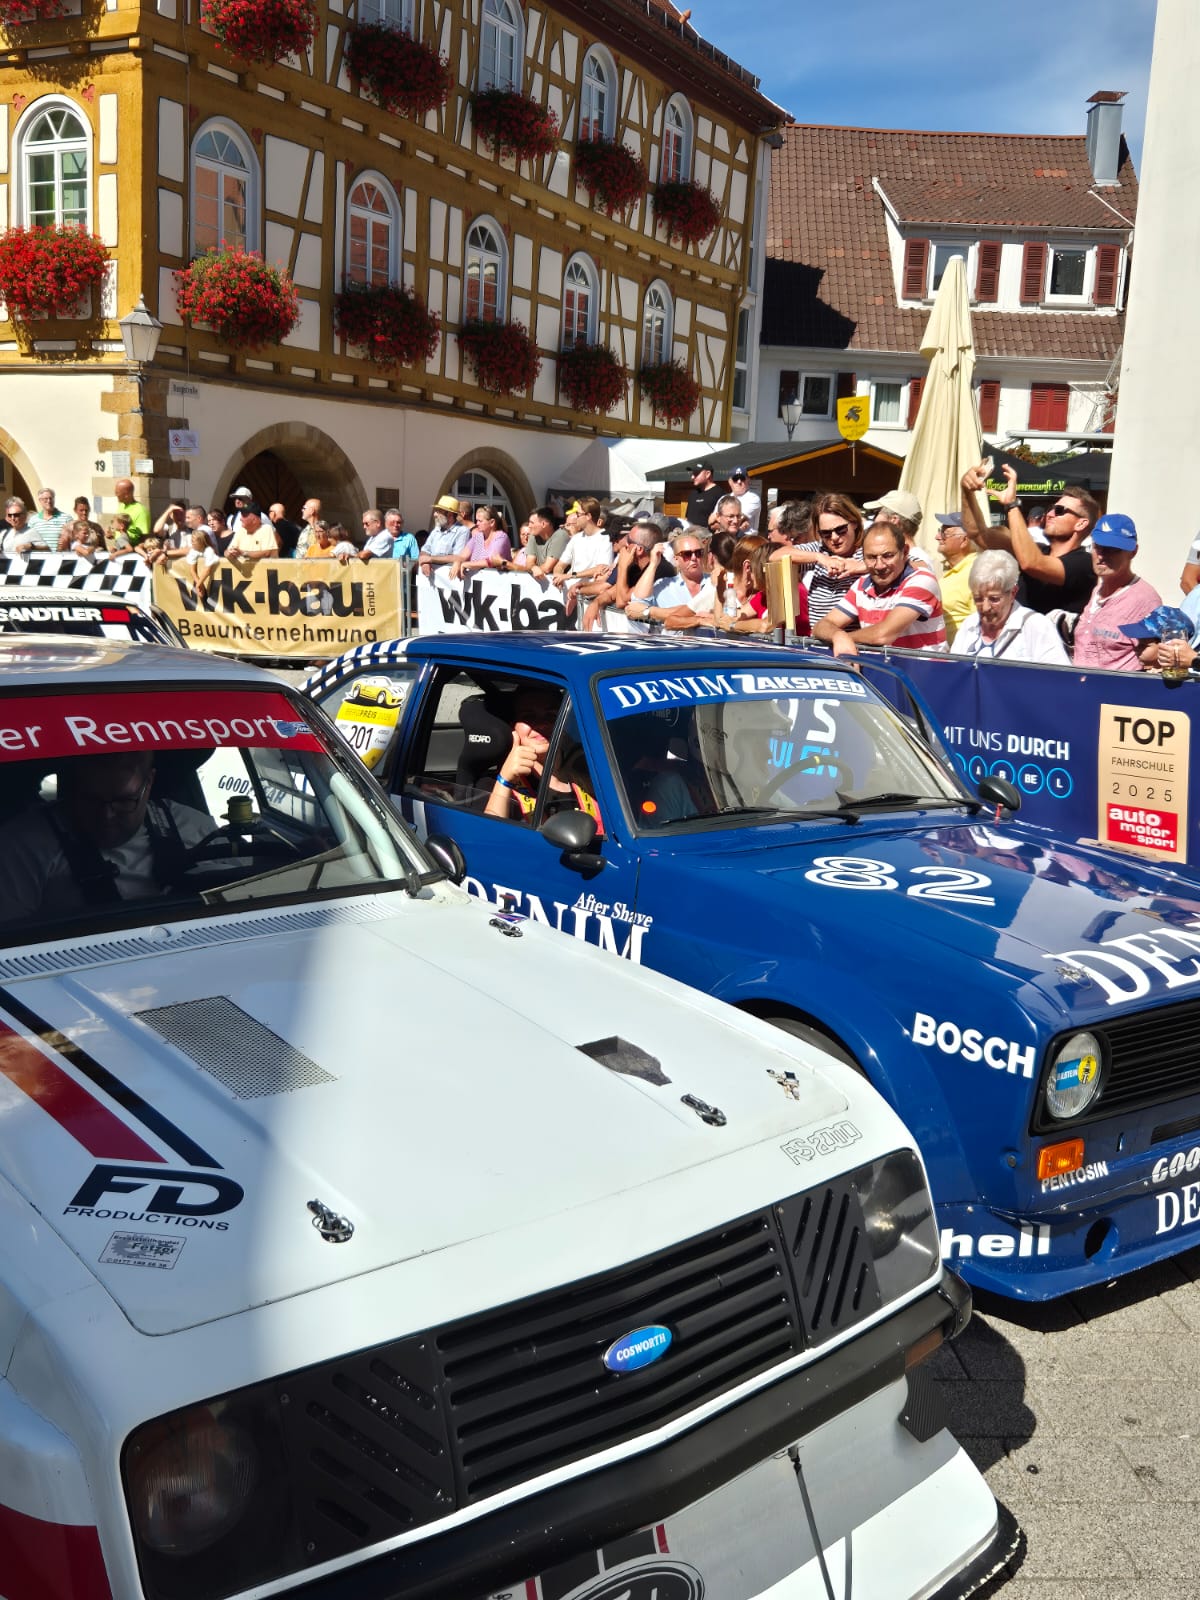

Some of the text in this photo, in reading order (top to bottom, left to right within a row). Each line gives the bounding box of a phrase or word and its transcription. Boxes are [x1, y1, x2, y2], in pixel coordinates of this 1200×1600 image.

[94, 459, 106, 472] 19
[175, 567, 365, 618] wk-bau
[367, 582, 377, 617] GmbH
[437, 579, 578, 632] wk-ba
[0, 607, 103, 622] SANDTLER
[178, 618, 378, 644] Bauunternehmung
[609, 673, 868, 709] DENIM ZAKSPEED
[64, 714, 291, 745] Rennsport
[348, 724, 374, 751] 201
[969, 728, 1002, 751] UNS
[1007, 734, 1070, 761] DURCH
[1113, 715, 1176, 747] TOP
[1111, 756, 1175, 773] FAHRSCHULE
[1024, 773, 1038, 784] BE
[1056, 778, 1064, 788] L
[1108, 807, 1162, 827] auto
[1120, 822, 1172, 838] motor
[1136, 834, 1176, 849] sport
[804, 856, 996, 907] 82
[574, 891, 654, 928] After Shave
[912, 1011, 1037, 1079] BOSCH
[780, 1138, 815, 1165] RS
[69, 1164, 245, 1216] FD
[1041, 1160, 1109, 1193] PENTOSIN
[62, 1206, 231, 1231] PRODUCTIONS
[1156, 1180, 1200, 1236] DE
[940, 1219, 1051, 1260] hell
[616, 1331, 668, 1362] COSWORTH
